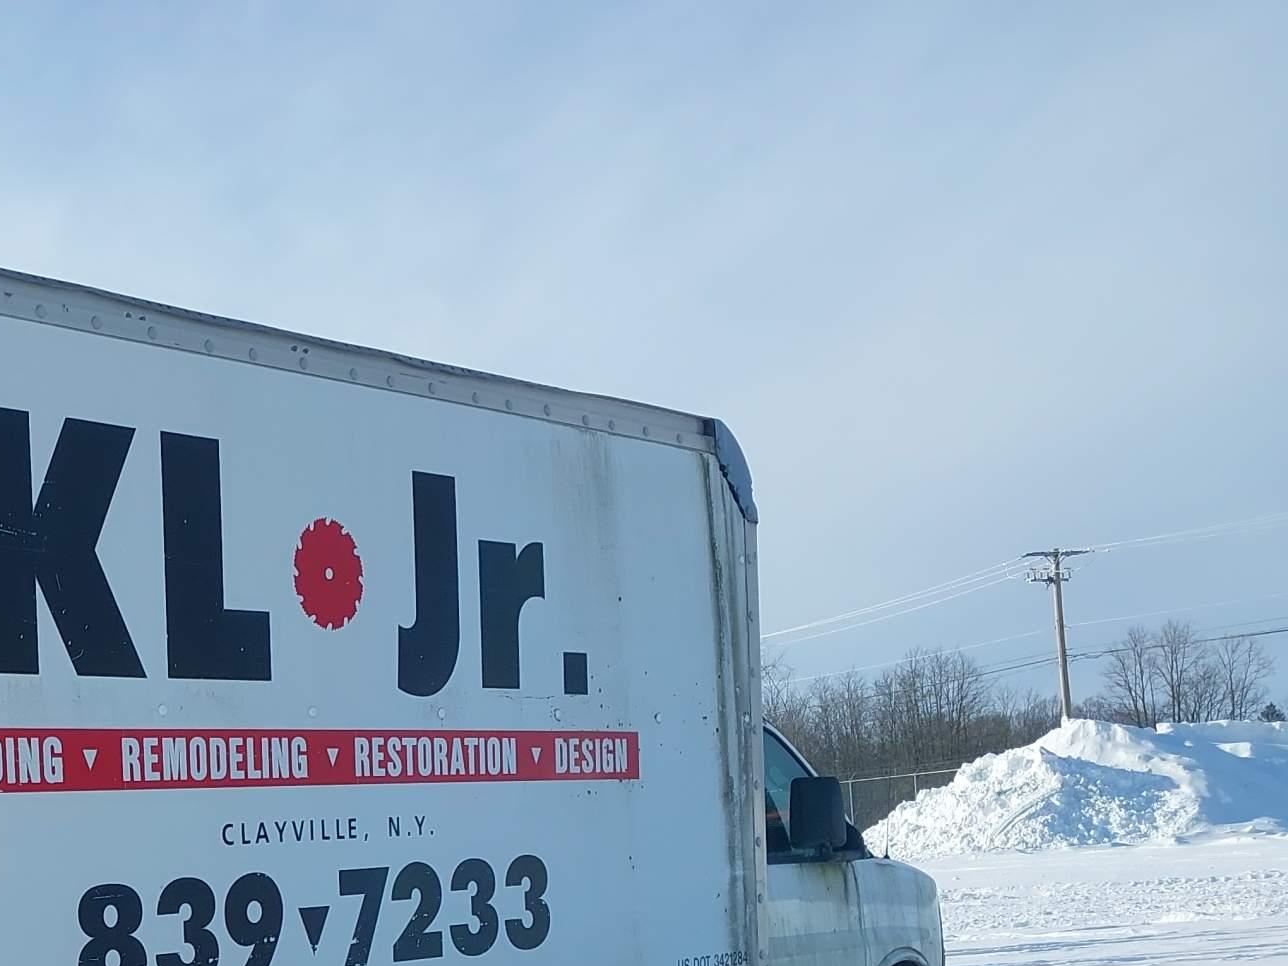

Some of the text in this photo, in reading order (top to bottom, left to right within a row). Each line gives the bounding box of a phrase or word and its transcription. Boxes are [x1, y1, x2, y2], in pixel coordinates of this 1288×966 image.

[397, 470, 589, 697] Jr.
[121, 736, 309, 782] REMODELING
[354, 736, 517, 777] RESTORATION
[554, 737, 628, 774] DESIGN
[221, 815, 436, 847] CLAYVILLE, N.Y.
